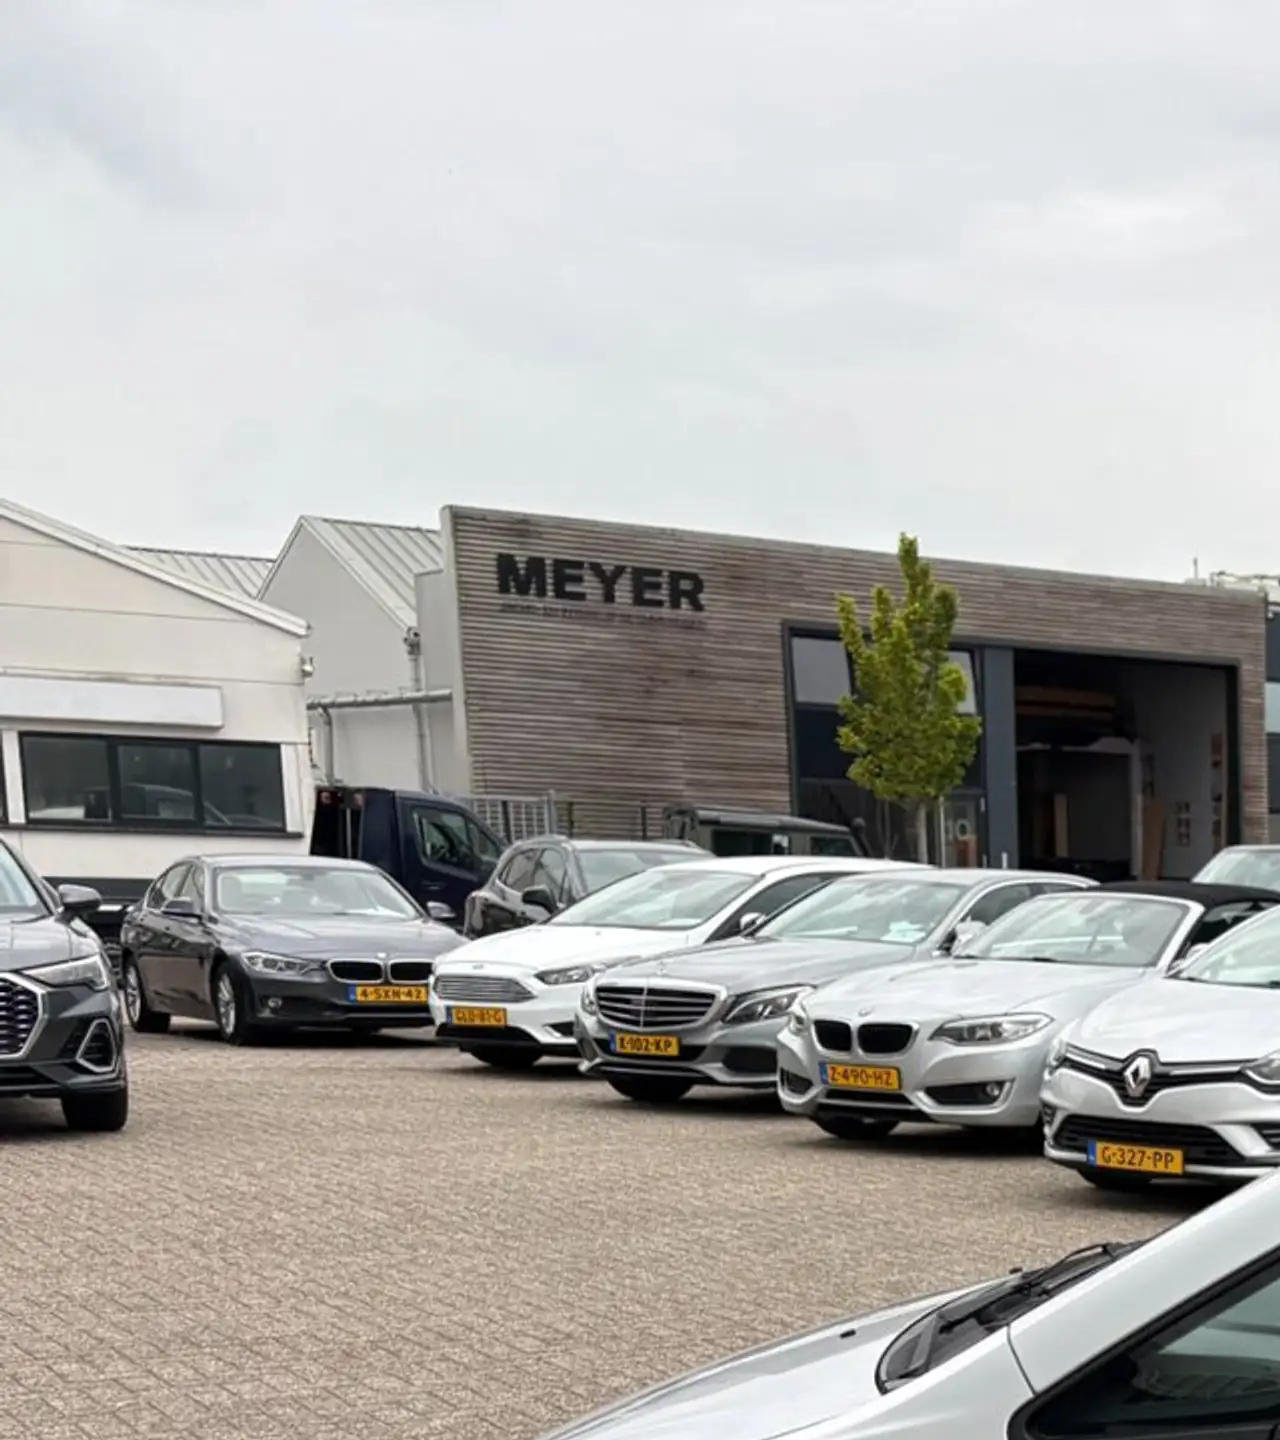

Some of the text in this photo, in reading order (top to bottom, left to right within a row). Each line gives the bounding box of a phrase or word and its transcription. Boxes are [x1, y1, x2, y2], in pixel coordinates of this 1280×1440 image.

[496, 553, 705, 612] MEYER
[829, 1066, 894, 1086] Z-490-HZ
[1101, 1145, 1175, 1170] G-327-PP
